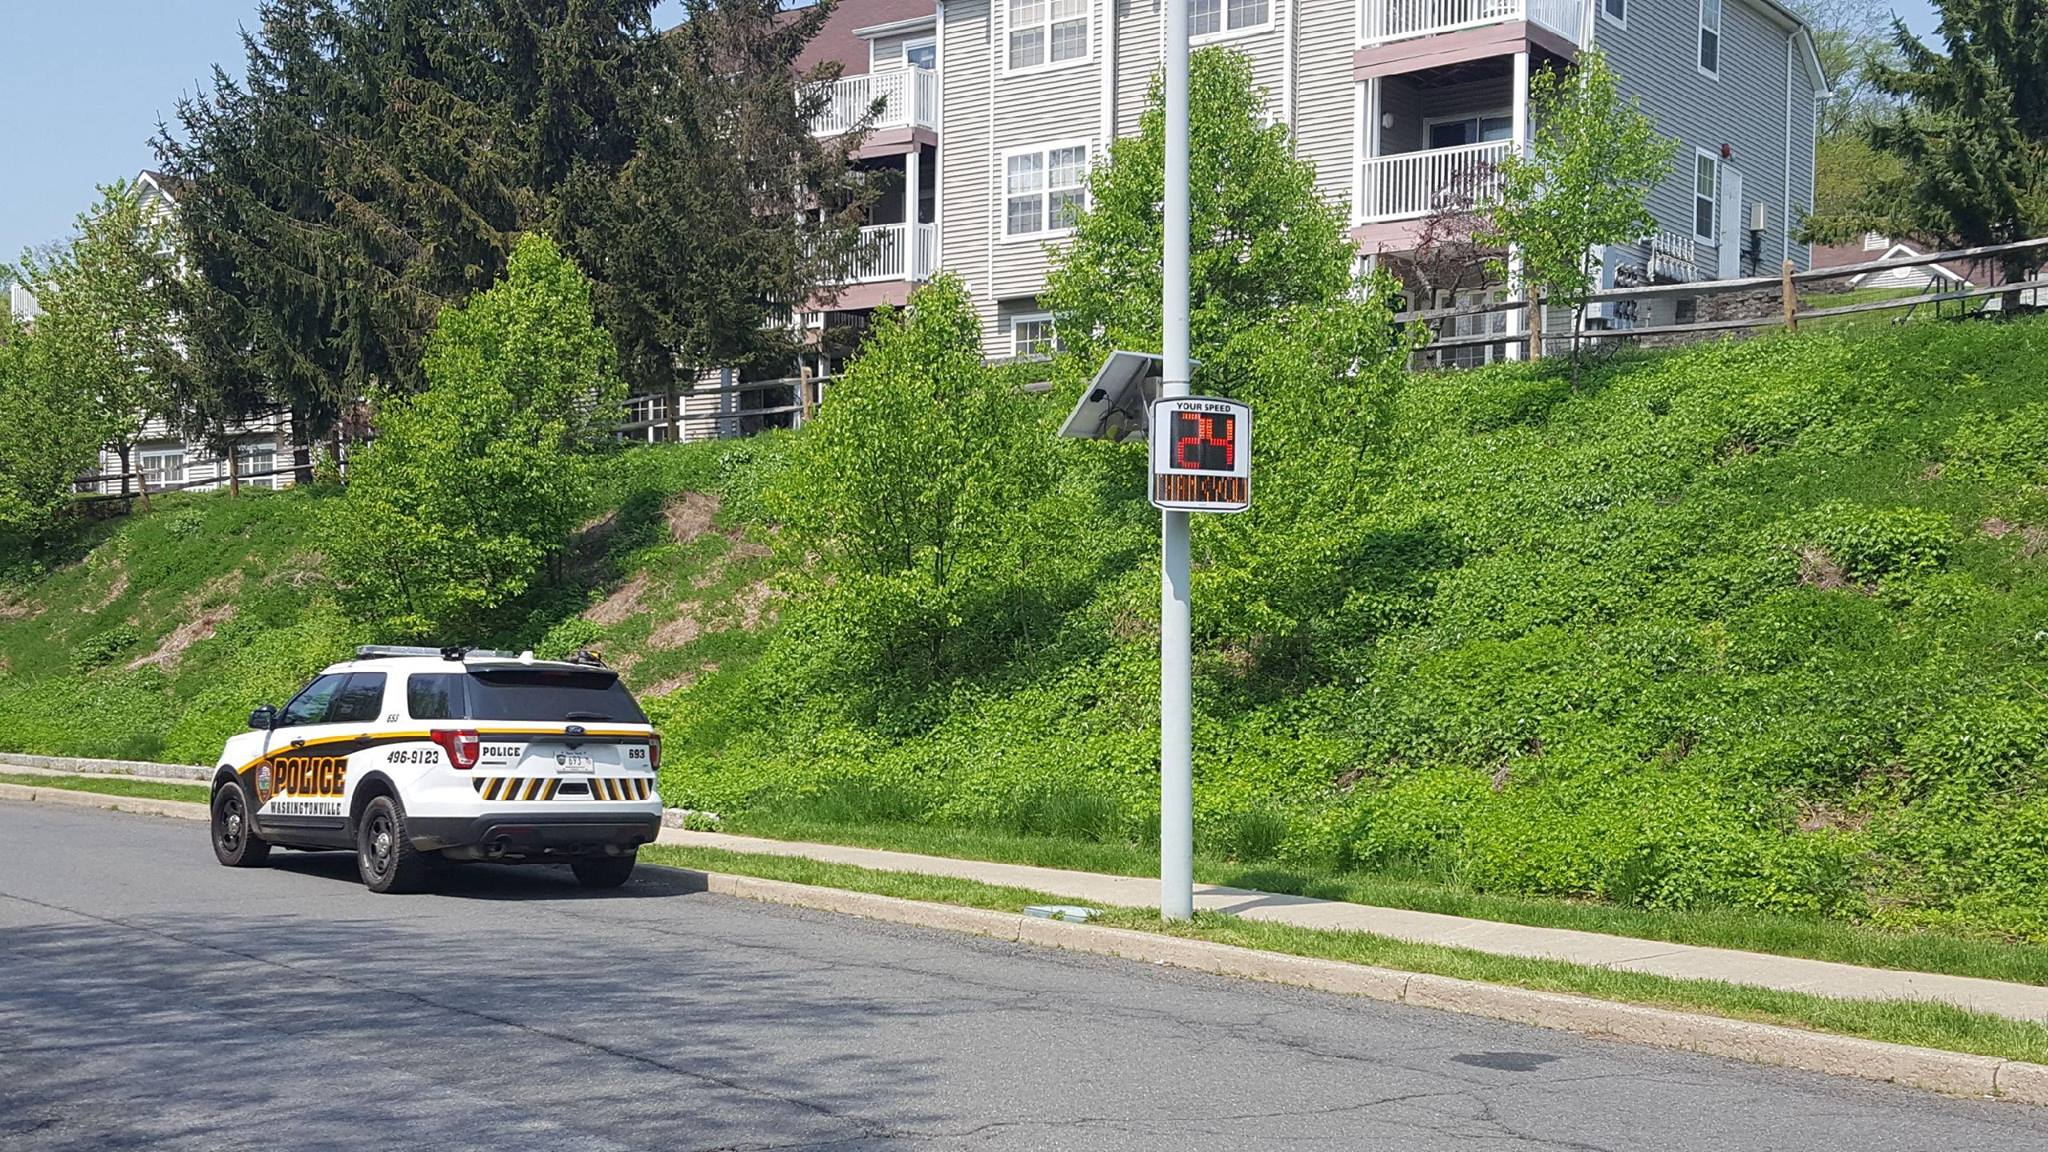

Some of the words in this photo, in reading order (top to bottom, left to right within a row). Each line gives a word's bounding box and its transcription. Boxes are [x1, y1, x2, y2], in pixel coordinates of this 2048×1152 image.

[1176, 402, 1202, 411] YOUR
[1204, 402, 1231, 412] SPEED
[1177, 412, 1233, 470] 24
[386, 750, 439, 764] 496-9123
[482, 746, 521, 757] POLICE
[628, 748, 646, 760] 693
[271, 756, 348, 798] POLICE
[270, 801, 342, 816] WASHINGTONVILLE
